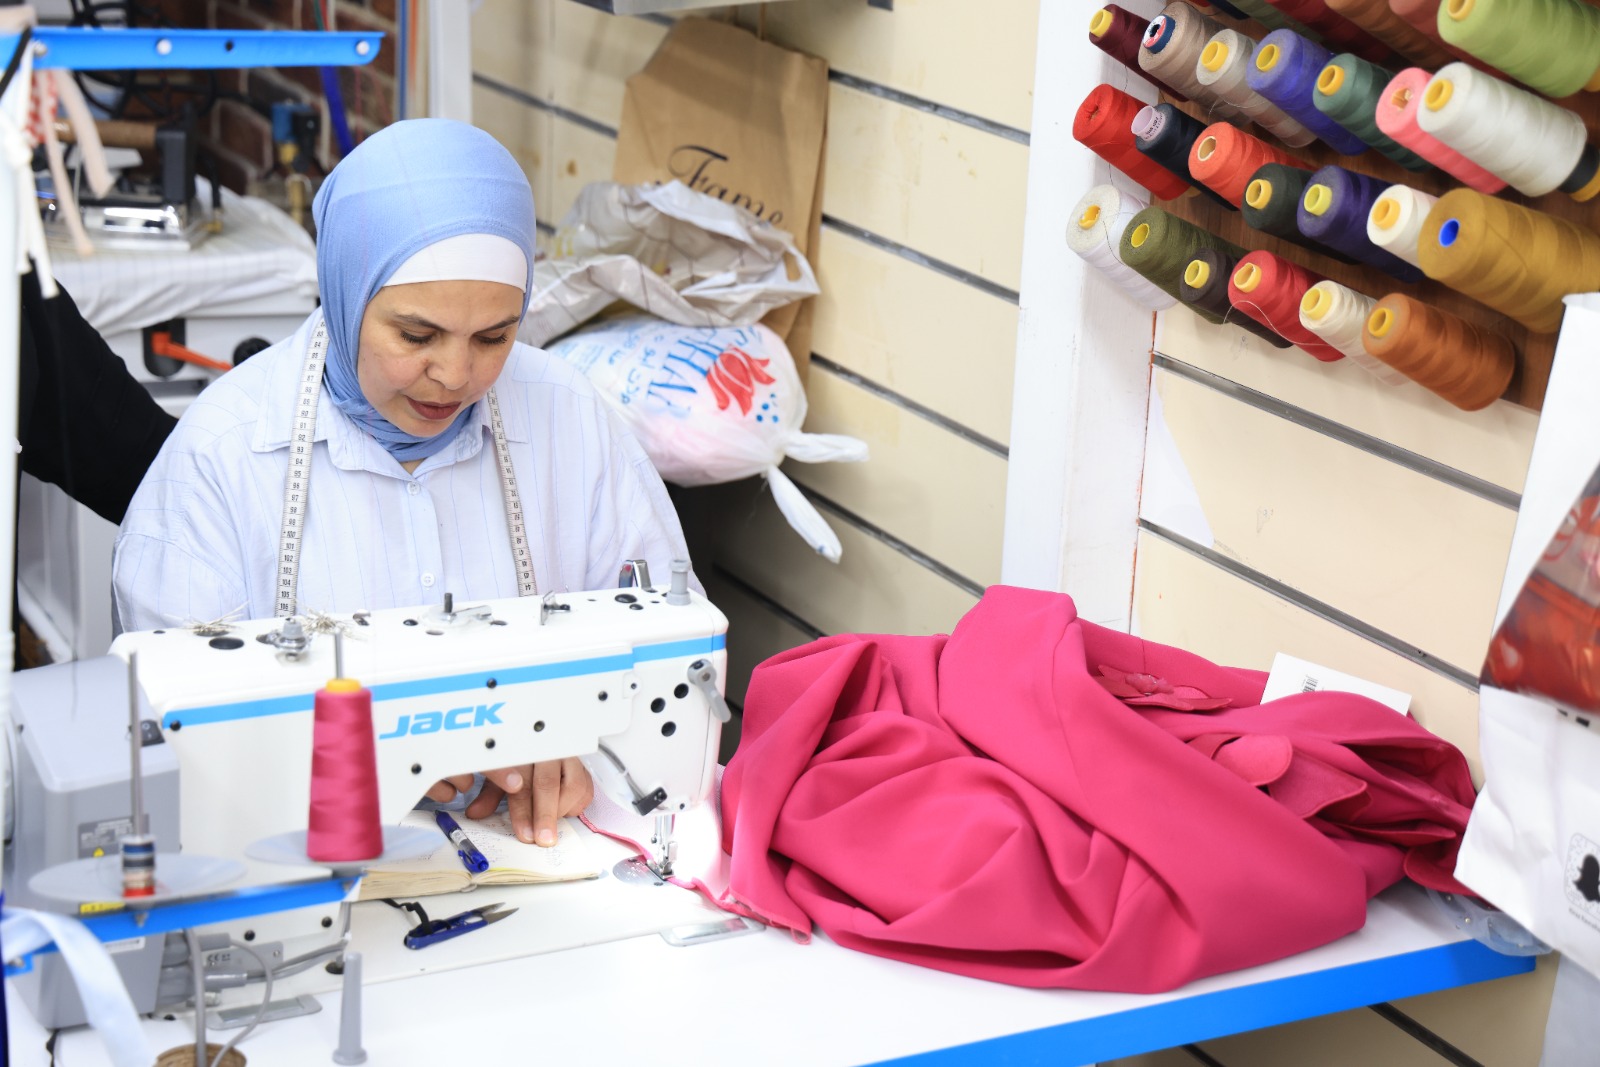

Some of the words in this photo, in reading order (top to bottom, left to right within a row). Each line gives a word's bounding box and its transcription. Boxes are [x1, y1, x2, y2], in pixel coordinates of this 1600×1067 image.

[298, 433, 306, 441] 92
[286, 530, 296, 538] 100
[379, 702, 506, 739] JACK
